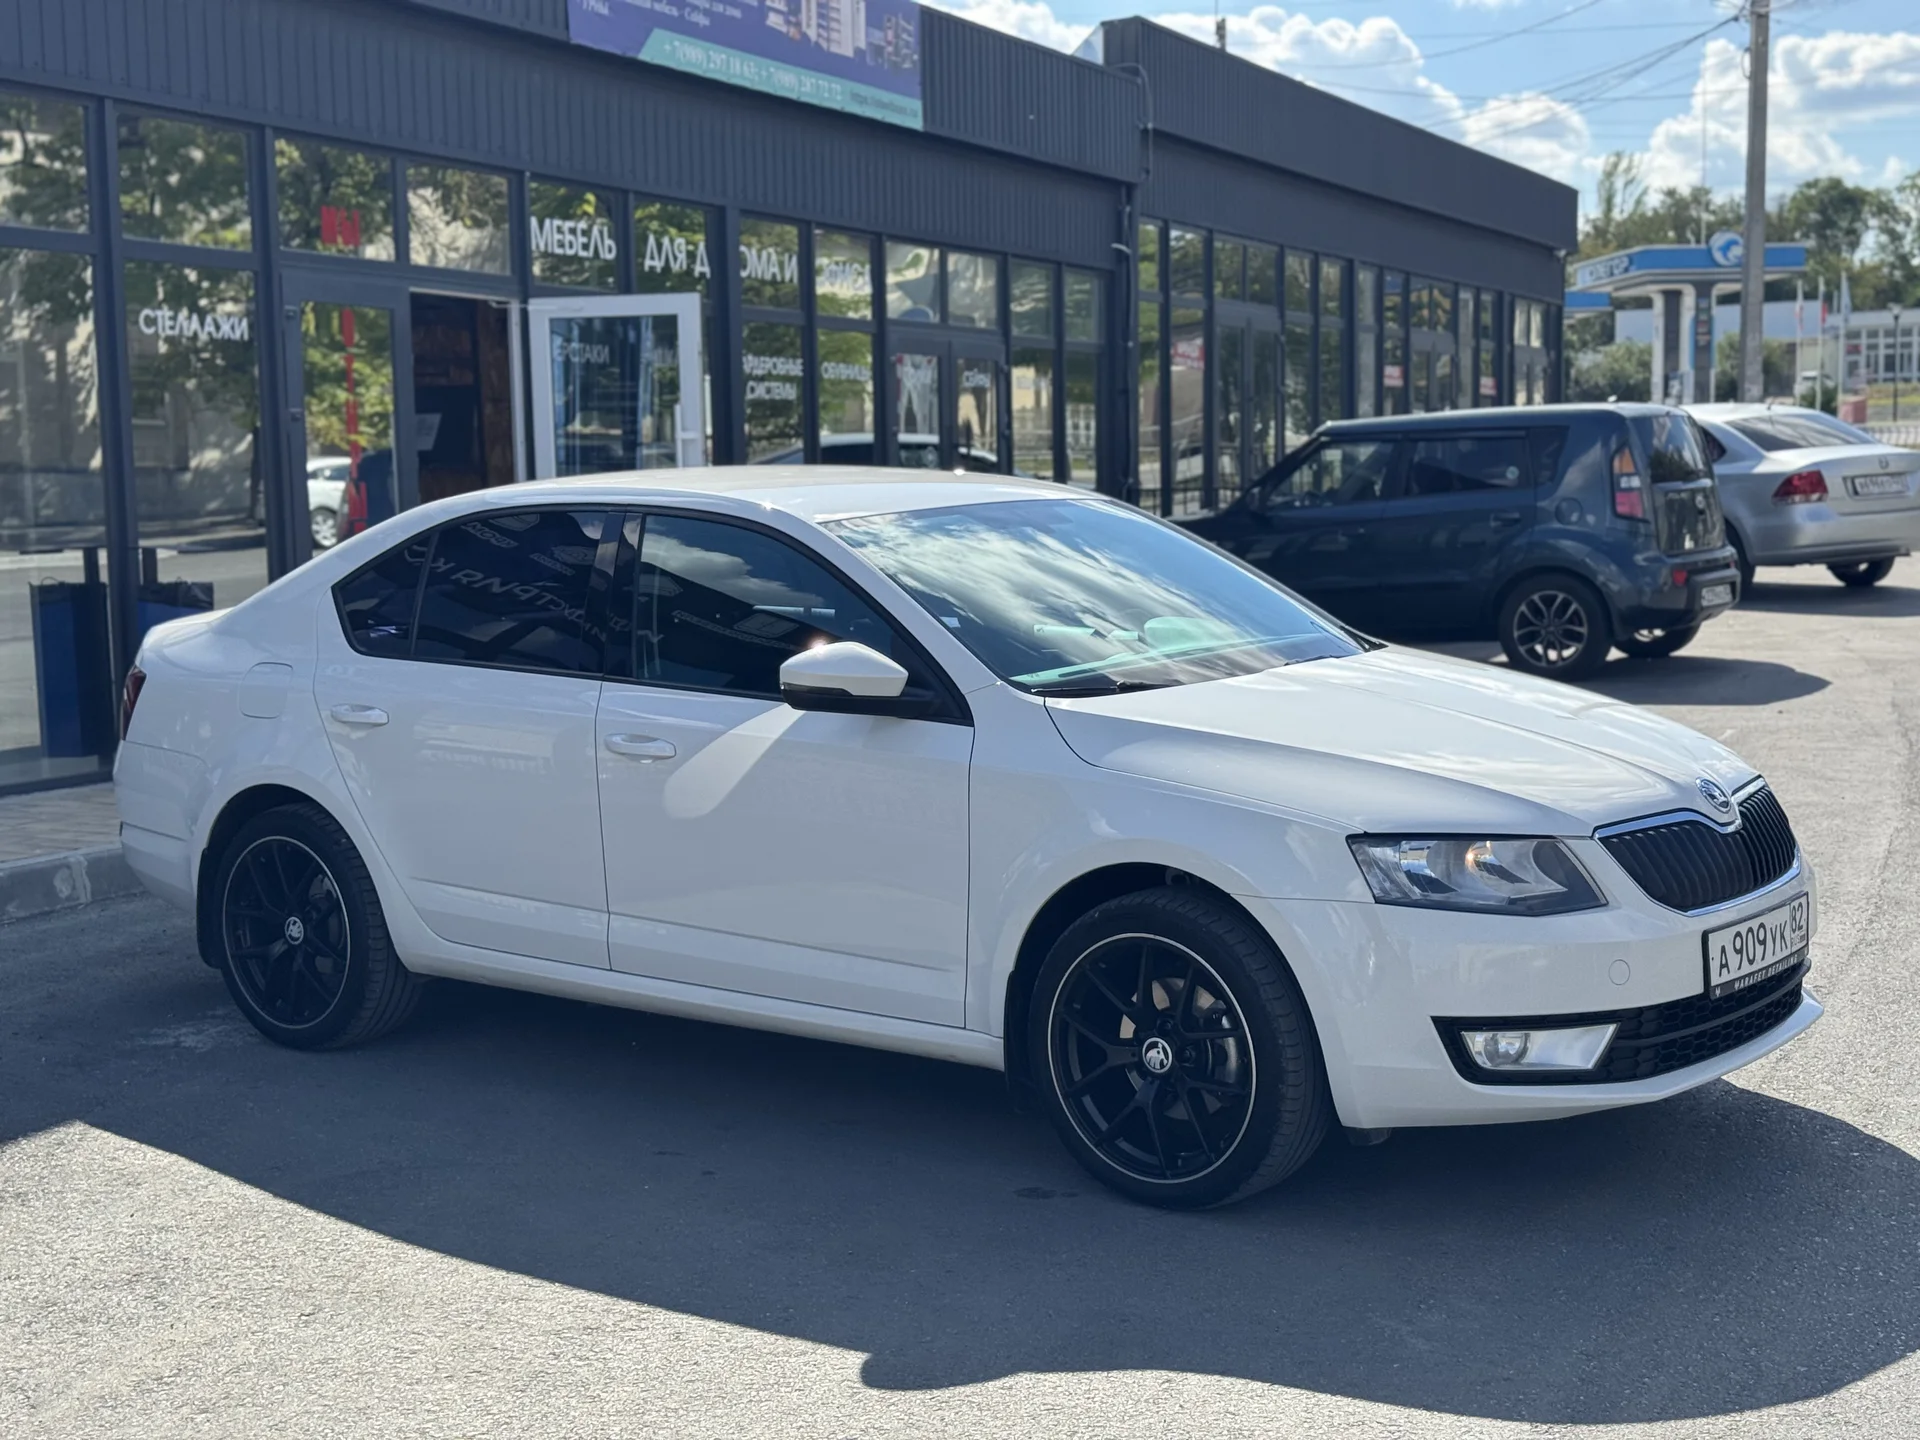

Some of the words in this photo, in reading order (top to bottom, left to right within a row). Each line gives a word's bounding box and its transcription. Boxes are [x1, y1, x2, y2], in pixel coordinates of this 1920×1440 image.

[530, 216, 617, 260] МЕБЕЛЬ
[644, 231, 688, 274] ДЛЯ
[784, 253, 798, 284] И
[138, 307, 249, 341] СТЕЛЛАЖИ
[1791, 901, 1804, 934] 82
[1768, 954, 1798, 977] DETAILING
